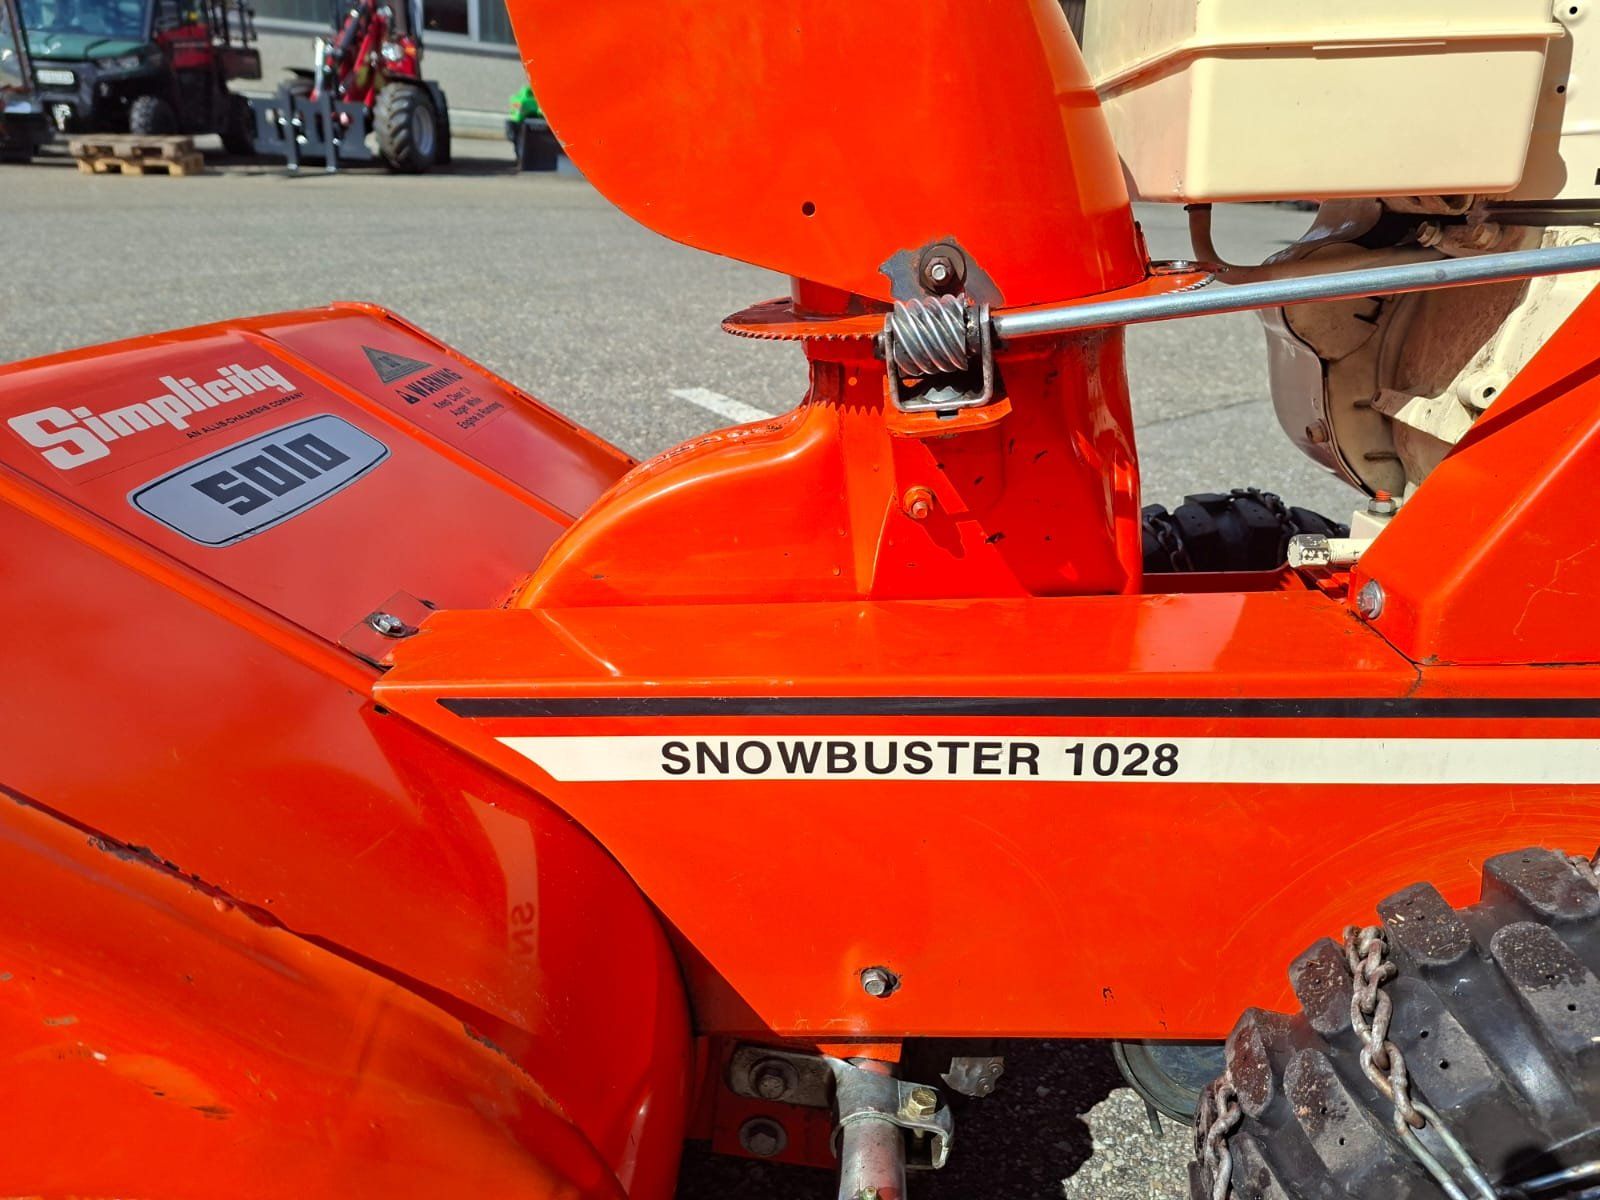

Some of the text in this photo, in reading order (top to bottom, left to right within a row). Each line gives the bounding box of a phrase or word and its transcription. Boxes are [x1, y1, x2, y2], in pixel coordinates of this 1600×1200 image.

[405, 367, 463, 398] WARNING
[432, 398, 453, 409] Keep
[7, 363, 297, 470] Simplicity
[186, 391, 305, 439] AN ALLIS-CHALMERS COMPANY
[190, 433, 351, 516] solo
[661, 741, 1180, 777] SNOWBUSTER 1028
